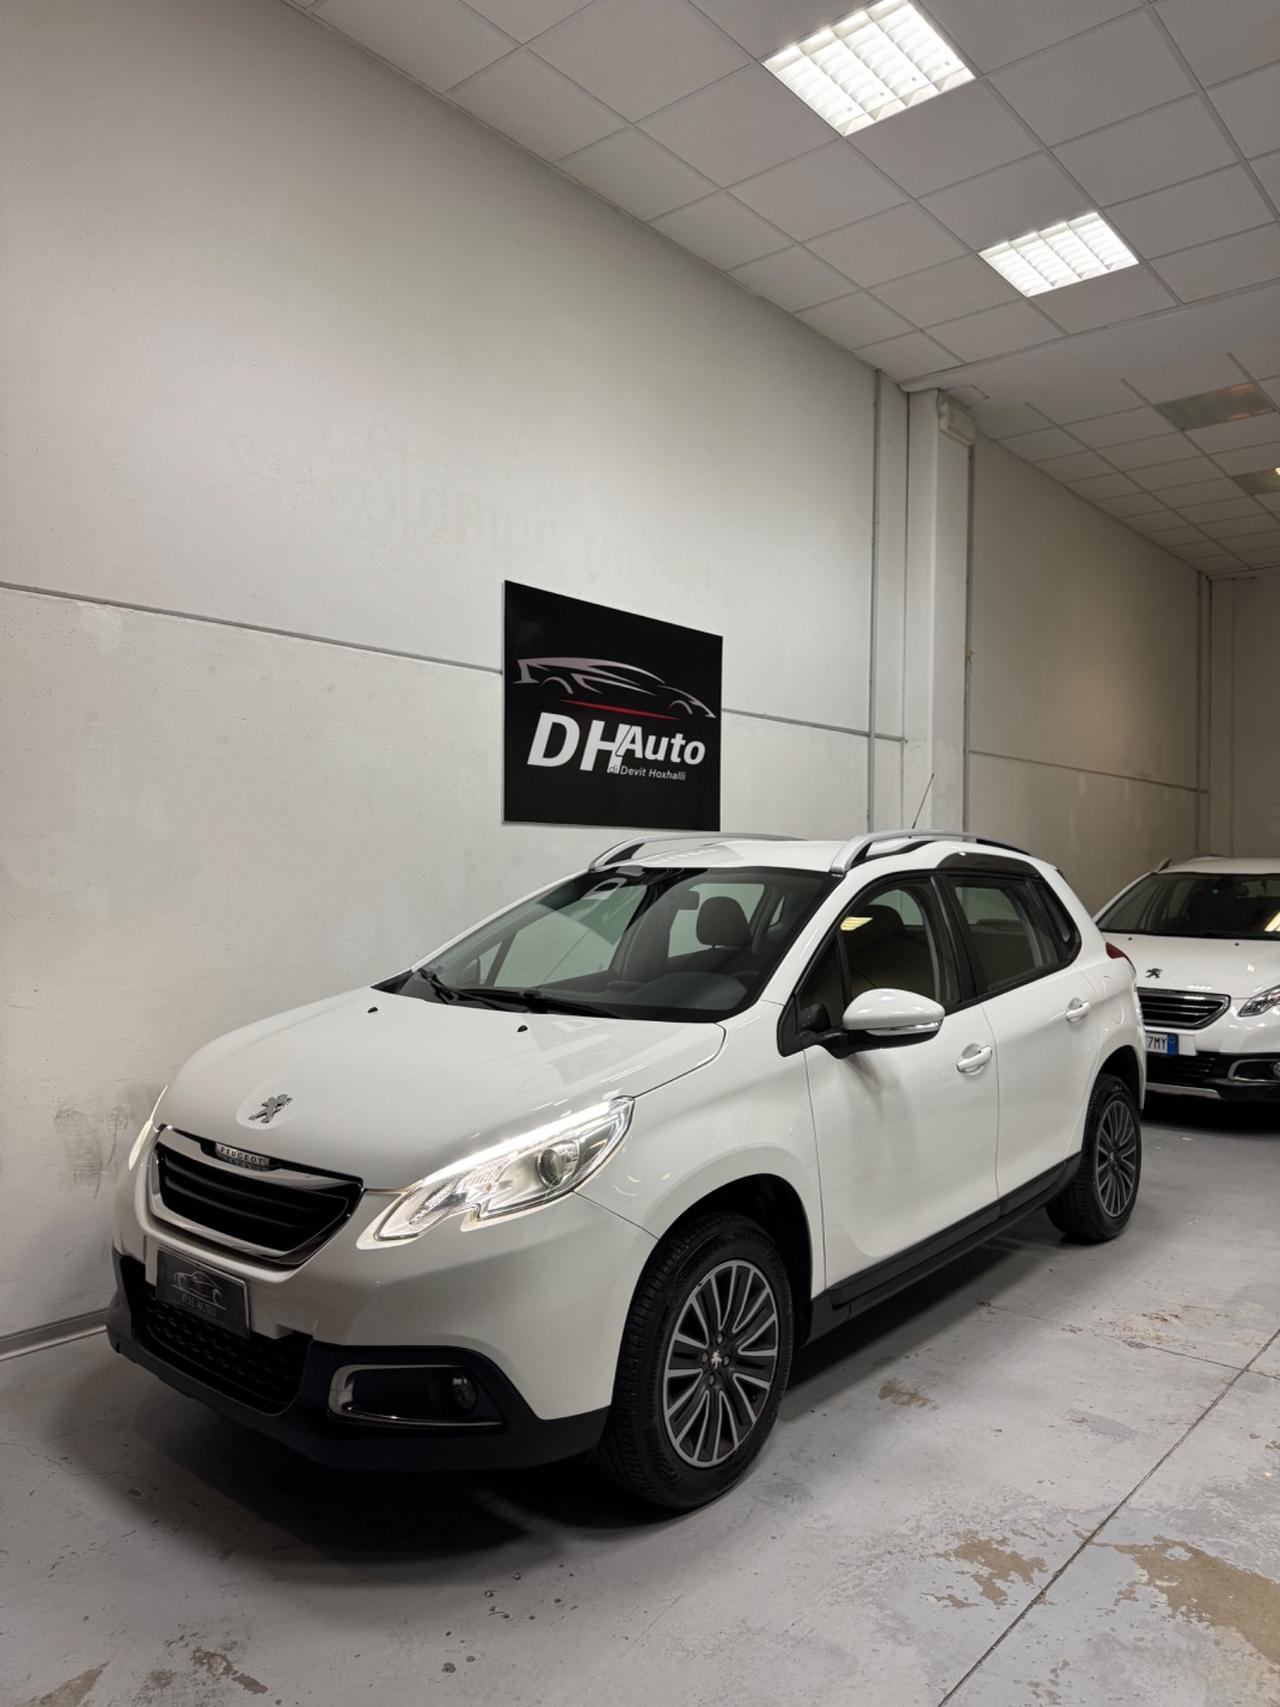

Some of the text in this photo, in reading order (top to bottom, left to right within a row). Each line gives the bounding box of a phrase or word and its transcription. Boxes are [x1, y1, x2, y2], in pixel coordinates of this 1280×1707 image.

[620, 765, 646, 776] Devit
[649, 767, 687, 781] Hoxhalli
[220, 1146, 264, 1165] PEUGEOT
